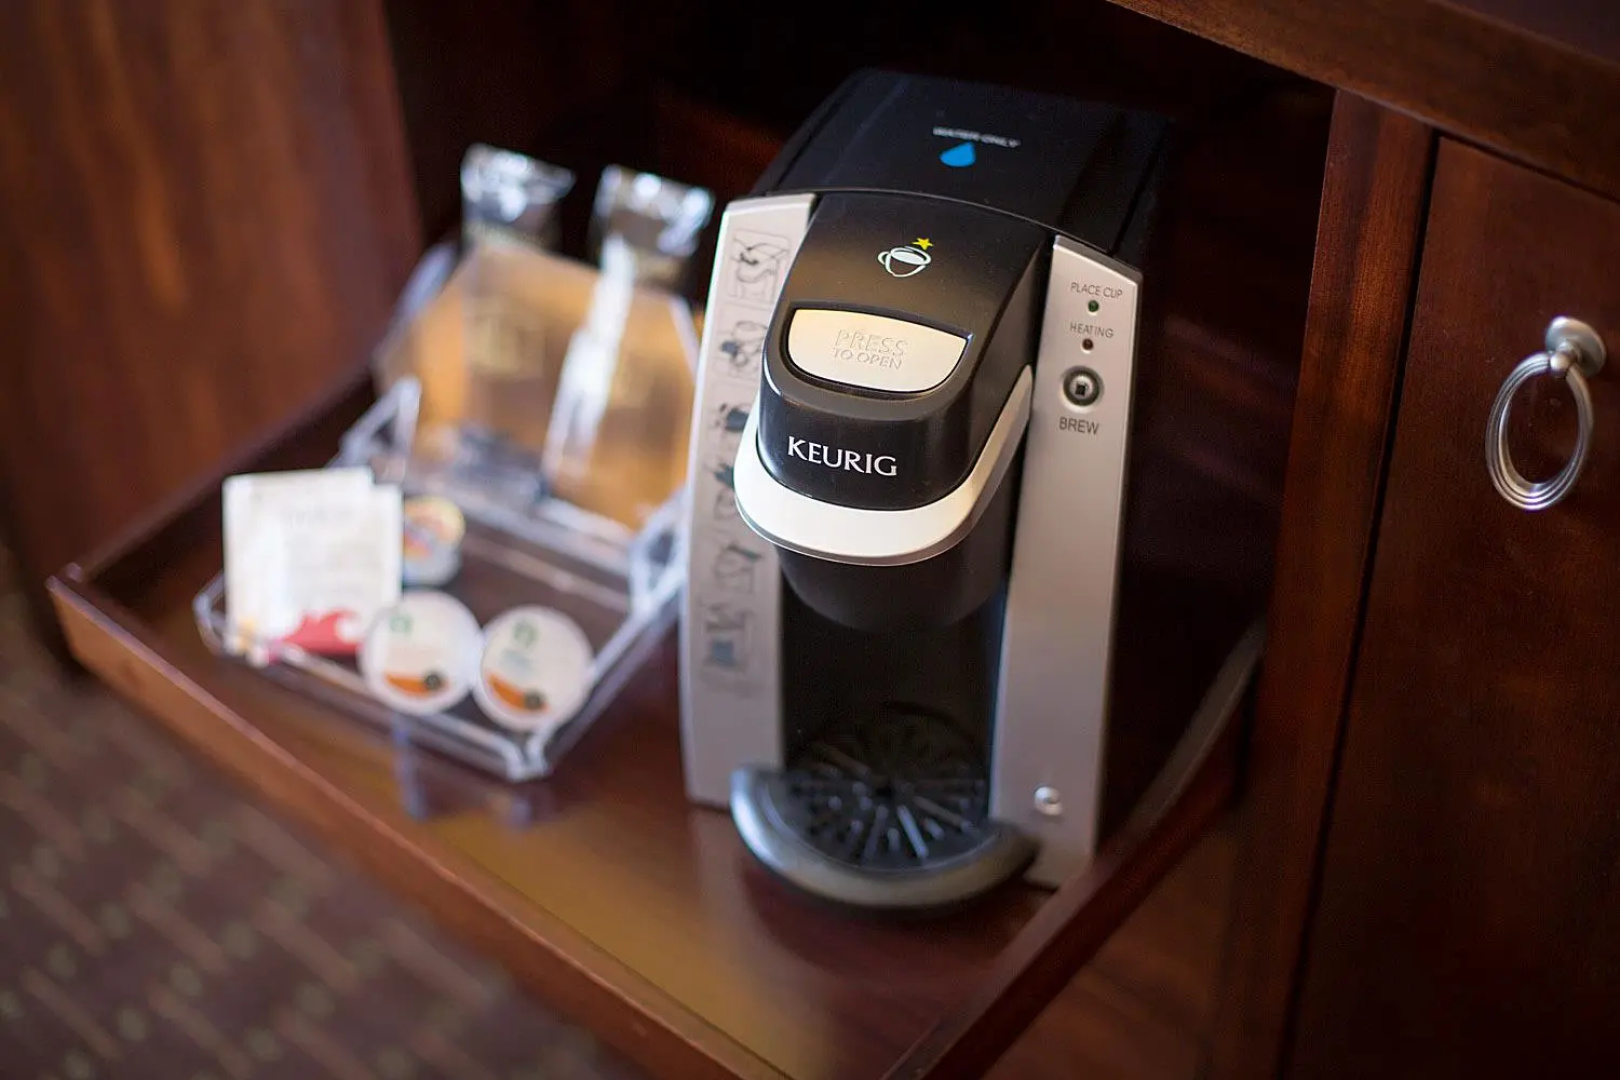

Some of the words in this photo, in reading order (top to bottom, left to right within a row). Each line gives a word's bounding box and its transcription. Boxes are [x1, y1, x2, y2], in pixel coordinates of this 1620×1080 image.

[1070, 281, 1101, 296] PLACE
[1103, 286, 1123, 299] CUP
[1069, 321, 1114, 338] HEATING
[835, 329, 907, 356] PRESS
[833, 347, 853, 360] TO
[857, 350, 903, 370] OPEN
[1059, 416, 1099, 435] BREW
[787, 435, 898, 476] KEURIG
